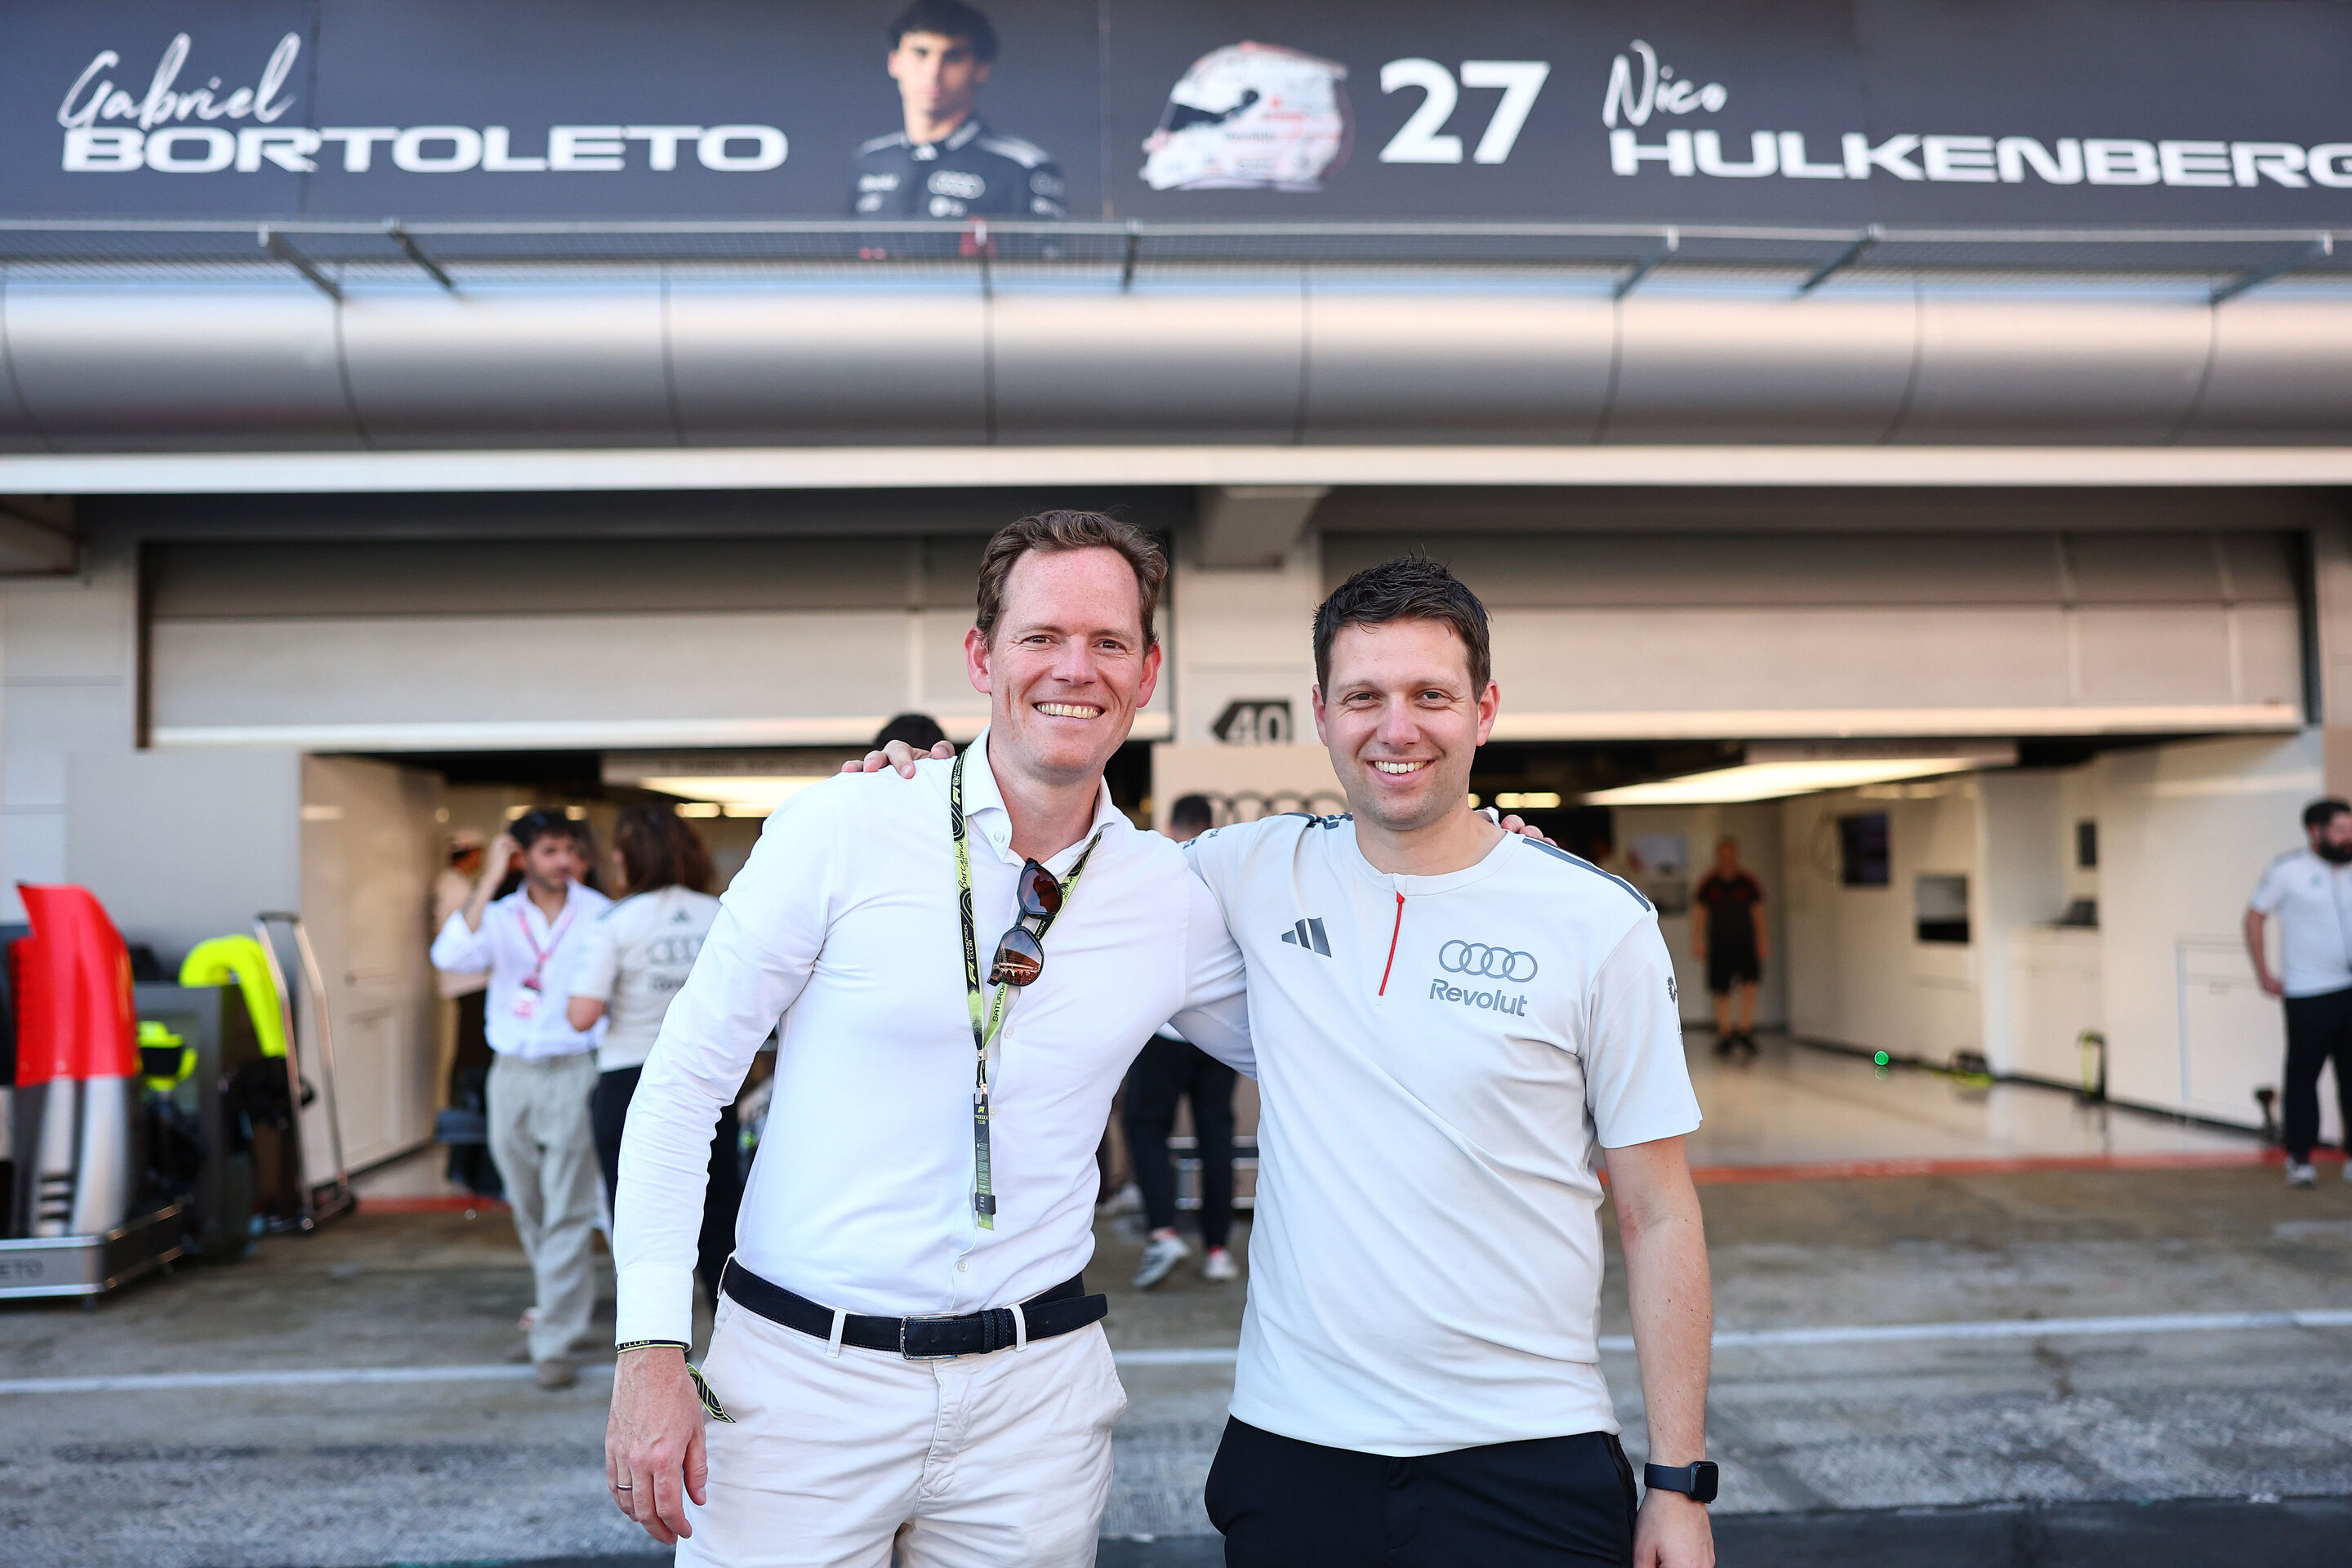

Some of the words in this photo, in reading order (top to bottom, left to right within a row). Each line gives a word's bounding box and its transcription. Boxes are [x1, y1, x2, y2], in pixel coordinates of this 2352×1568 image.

[57, 31, 301, 128] Gabriel
[1602, 39, 1727, 129] Nico
[1379, 57, 1550, 165] 27
[62, 124, 789, 173] BORTOLETO
[1226, 704, 1288, 744] 40
[992, 984, 1006, 1022] SATURD
[1429, 978, 1528, 1017] Revolut
